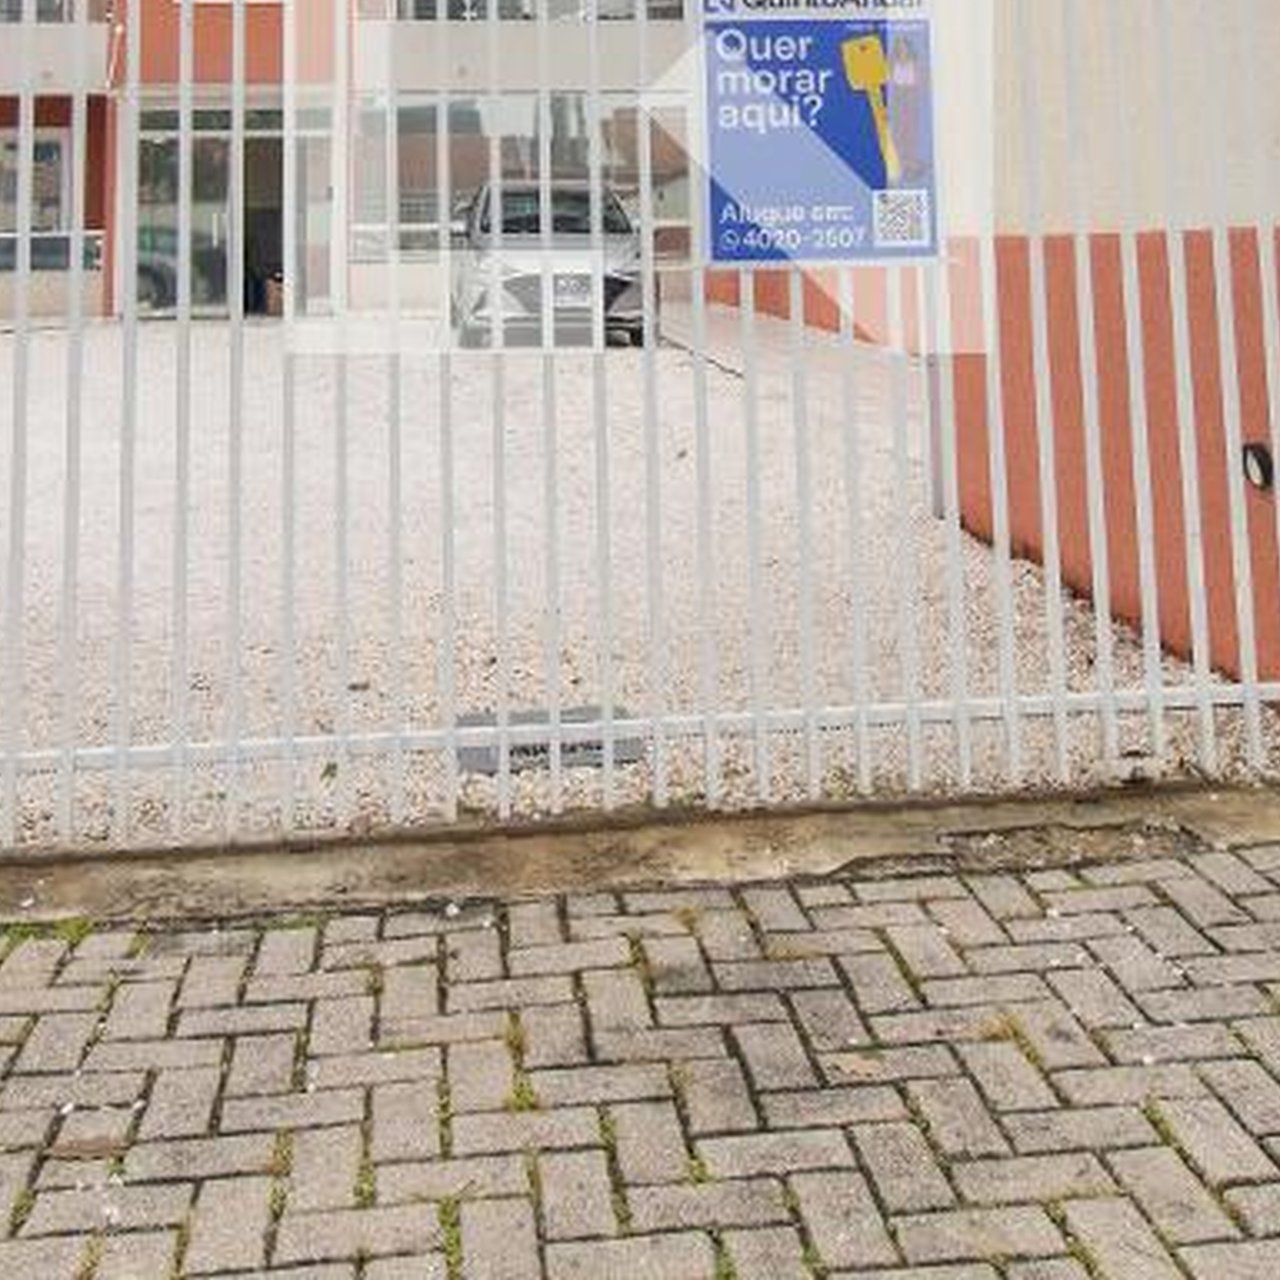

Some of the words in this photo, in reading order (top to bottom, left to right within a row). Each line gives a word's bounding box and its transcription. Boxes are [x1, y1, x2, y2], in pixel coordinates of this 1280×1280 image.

[716, 28, 814, 62] Quer
[718, 68, 834, 94] morar
[719, 96, 823, 135] aqui?
